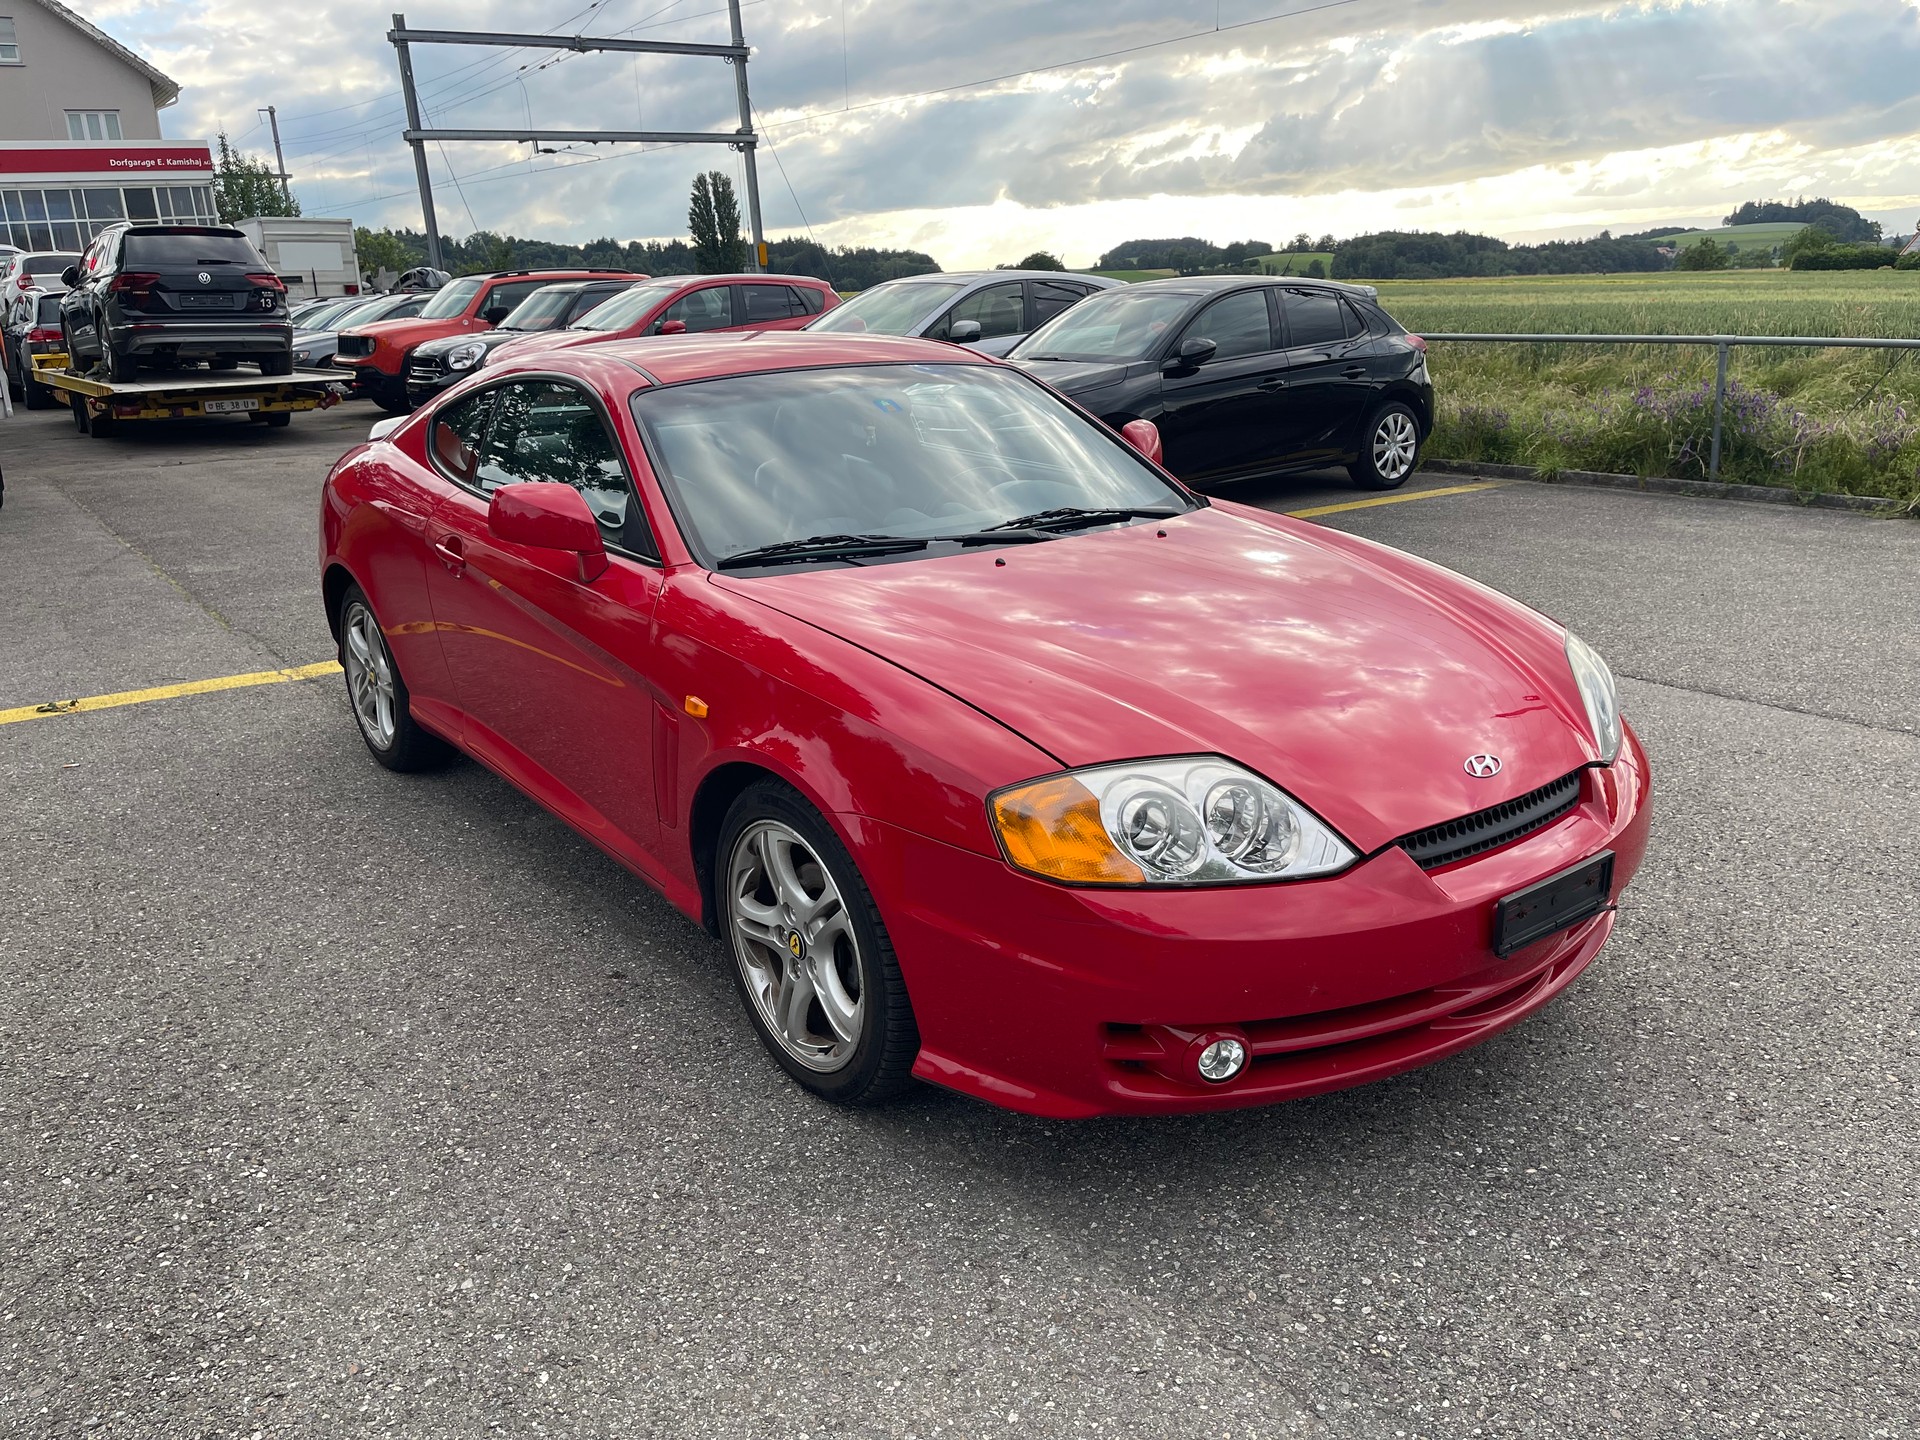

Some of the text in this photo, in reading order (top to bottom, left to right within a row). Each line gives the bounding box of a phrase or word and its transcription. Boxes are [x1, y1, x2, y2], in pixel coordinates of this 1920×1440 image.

[109, 159, 156, 168] Dorfgarage
[157, 158, 165, 166] E.
[166, 158, 202, 167] Kamishaj
[260, 298, 272, 308] 13
[230, 401, 240, 409] 38
